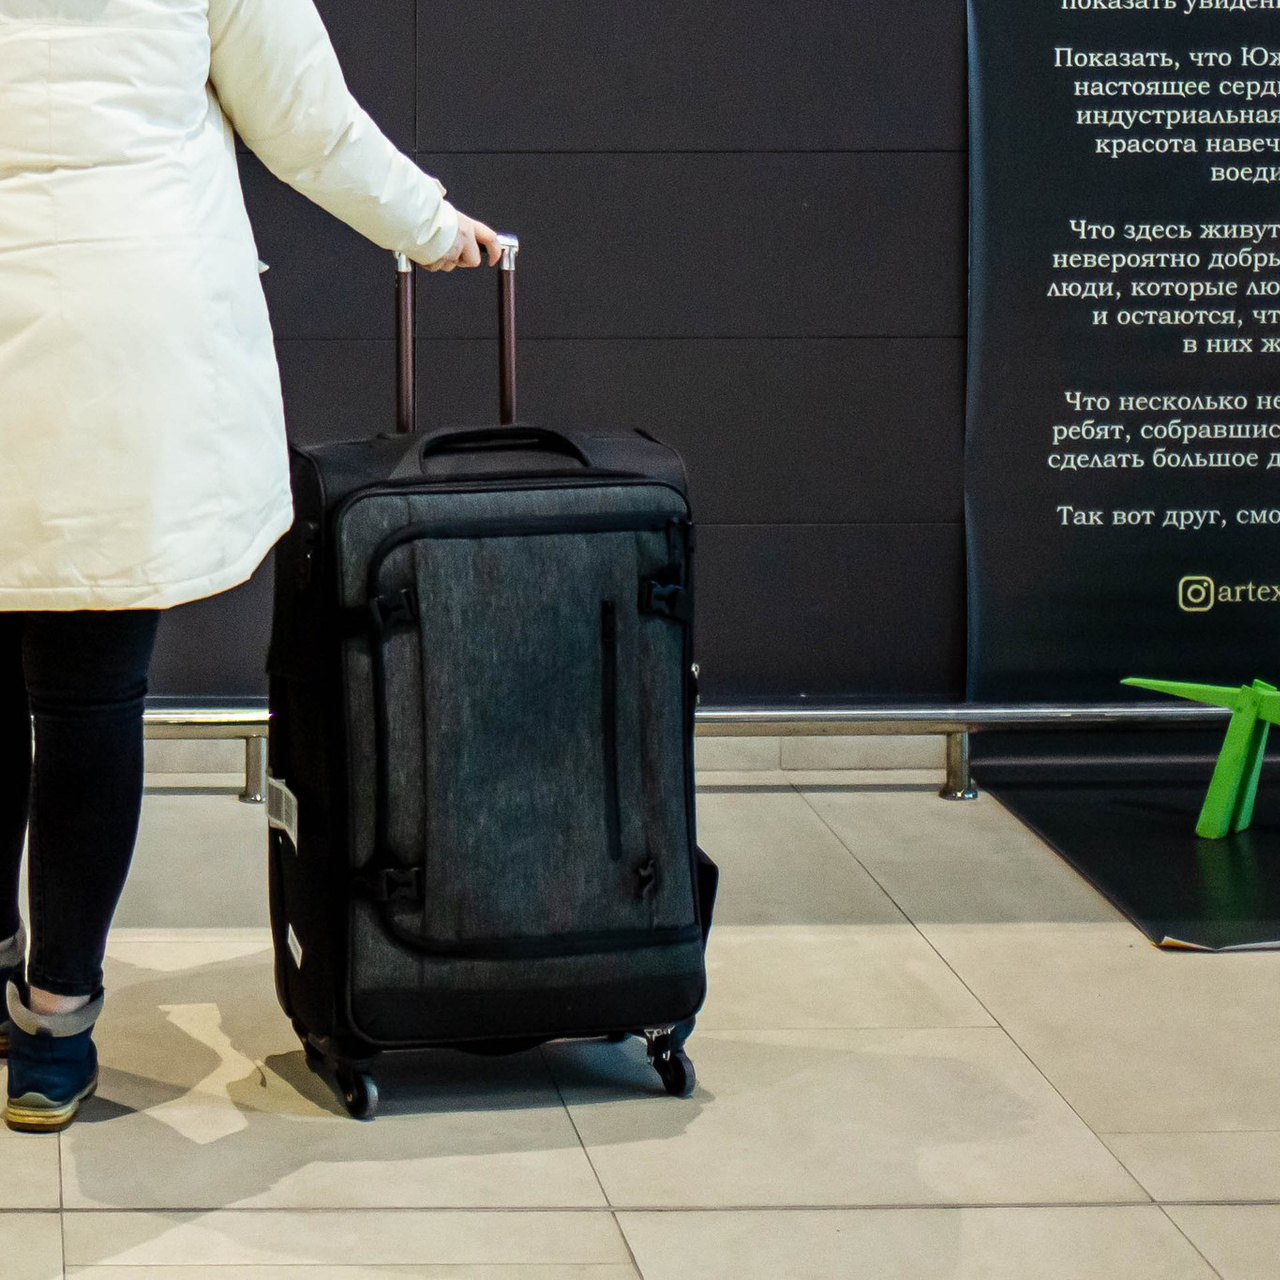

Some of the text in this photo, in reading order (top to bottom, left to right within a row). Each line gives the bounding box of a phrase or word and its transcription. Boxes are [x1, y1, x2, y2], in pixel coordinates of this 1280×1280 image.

[1054, 47, 1180, 71] Показать,
[1188, 51, 1232, 67] что
[1073, 80, 1280, 101] настоящее серд
[1076, 109, 1280, 130] индустриальная
[1095, 137, 1280, 159] красота навеч
[1068, 219, 1280, 244] Что здесь живут
[1052, 253, 1201, 274] невероятно
[1046, 281, 1280, 302] люди, которые лю
[1092, 309, 1280, 328] и остаются, чт
[1182, 338, 1198, 353] в
[1206, 338, 1253, 353] них
[1064, 391, 1111, 411] Что
[1118, 395, 1248, 411] несколько
[1052, 418, 1280, 446] ребят, собравшис
[1047, 453, 1145, 471] сделать
[1152, 447, 1259, 468] большое
[1056, 505, 1280, 530] Так вот друг, смо
